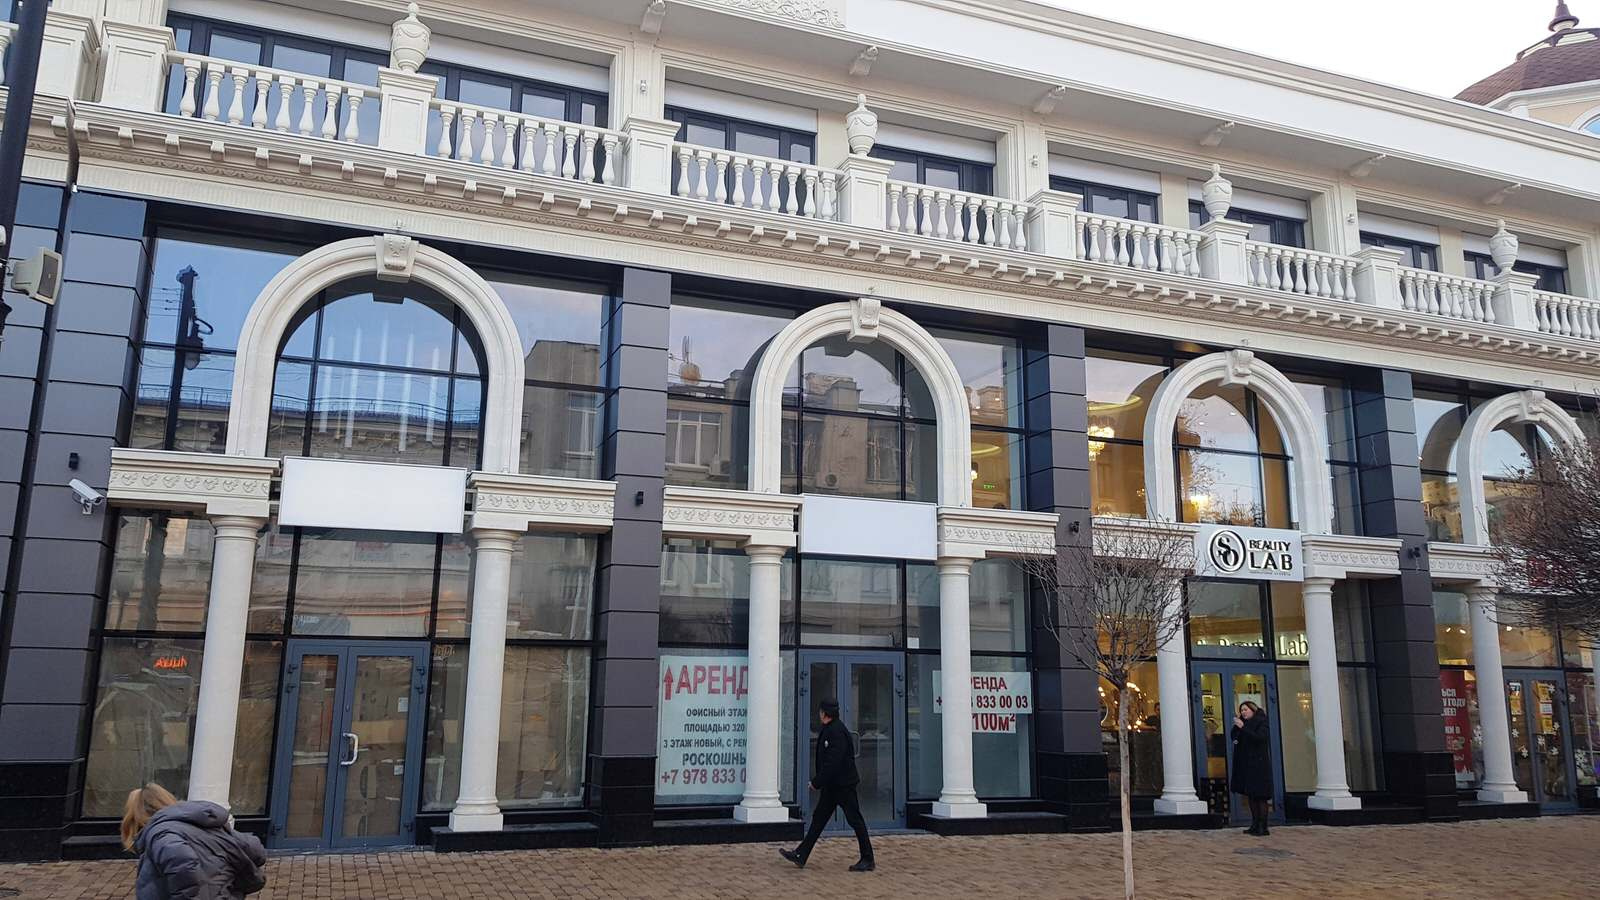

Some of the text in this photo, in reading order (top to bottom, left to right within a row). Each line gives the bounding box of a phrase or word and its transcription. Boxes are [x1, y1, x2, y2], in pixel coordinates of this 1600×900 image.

[1248, 539, 1291, 551] BEAUTY
[1249, 552, 1293, 570] LAB
[1279, 632, 1309, 656] Lab
[976, 695, 996, 708] 833
[1000, 695, 1012, 708] 00
[1016, 695, 1028, 708] 03
[686, 706, 726, 718] ОФИСНЫЙ
[684, 723, 745, 734] ПЛОЩАДЬЮ 320
[664, 739, 668, 749] 3
[670, 739, 692, 749] ЭТАЖ
[727, 739, 731, 748] С
[661, 768, 679, 785] +7
[683, 768, 707, 785] 978
[712, 768, 736, 784] 833
